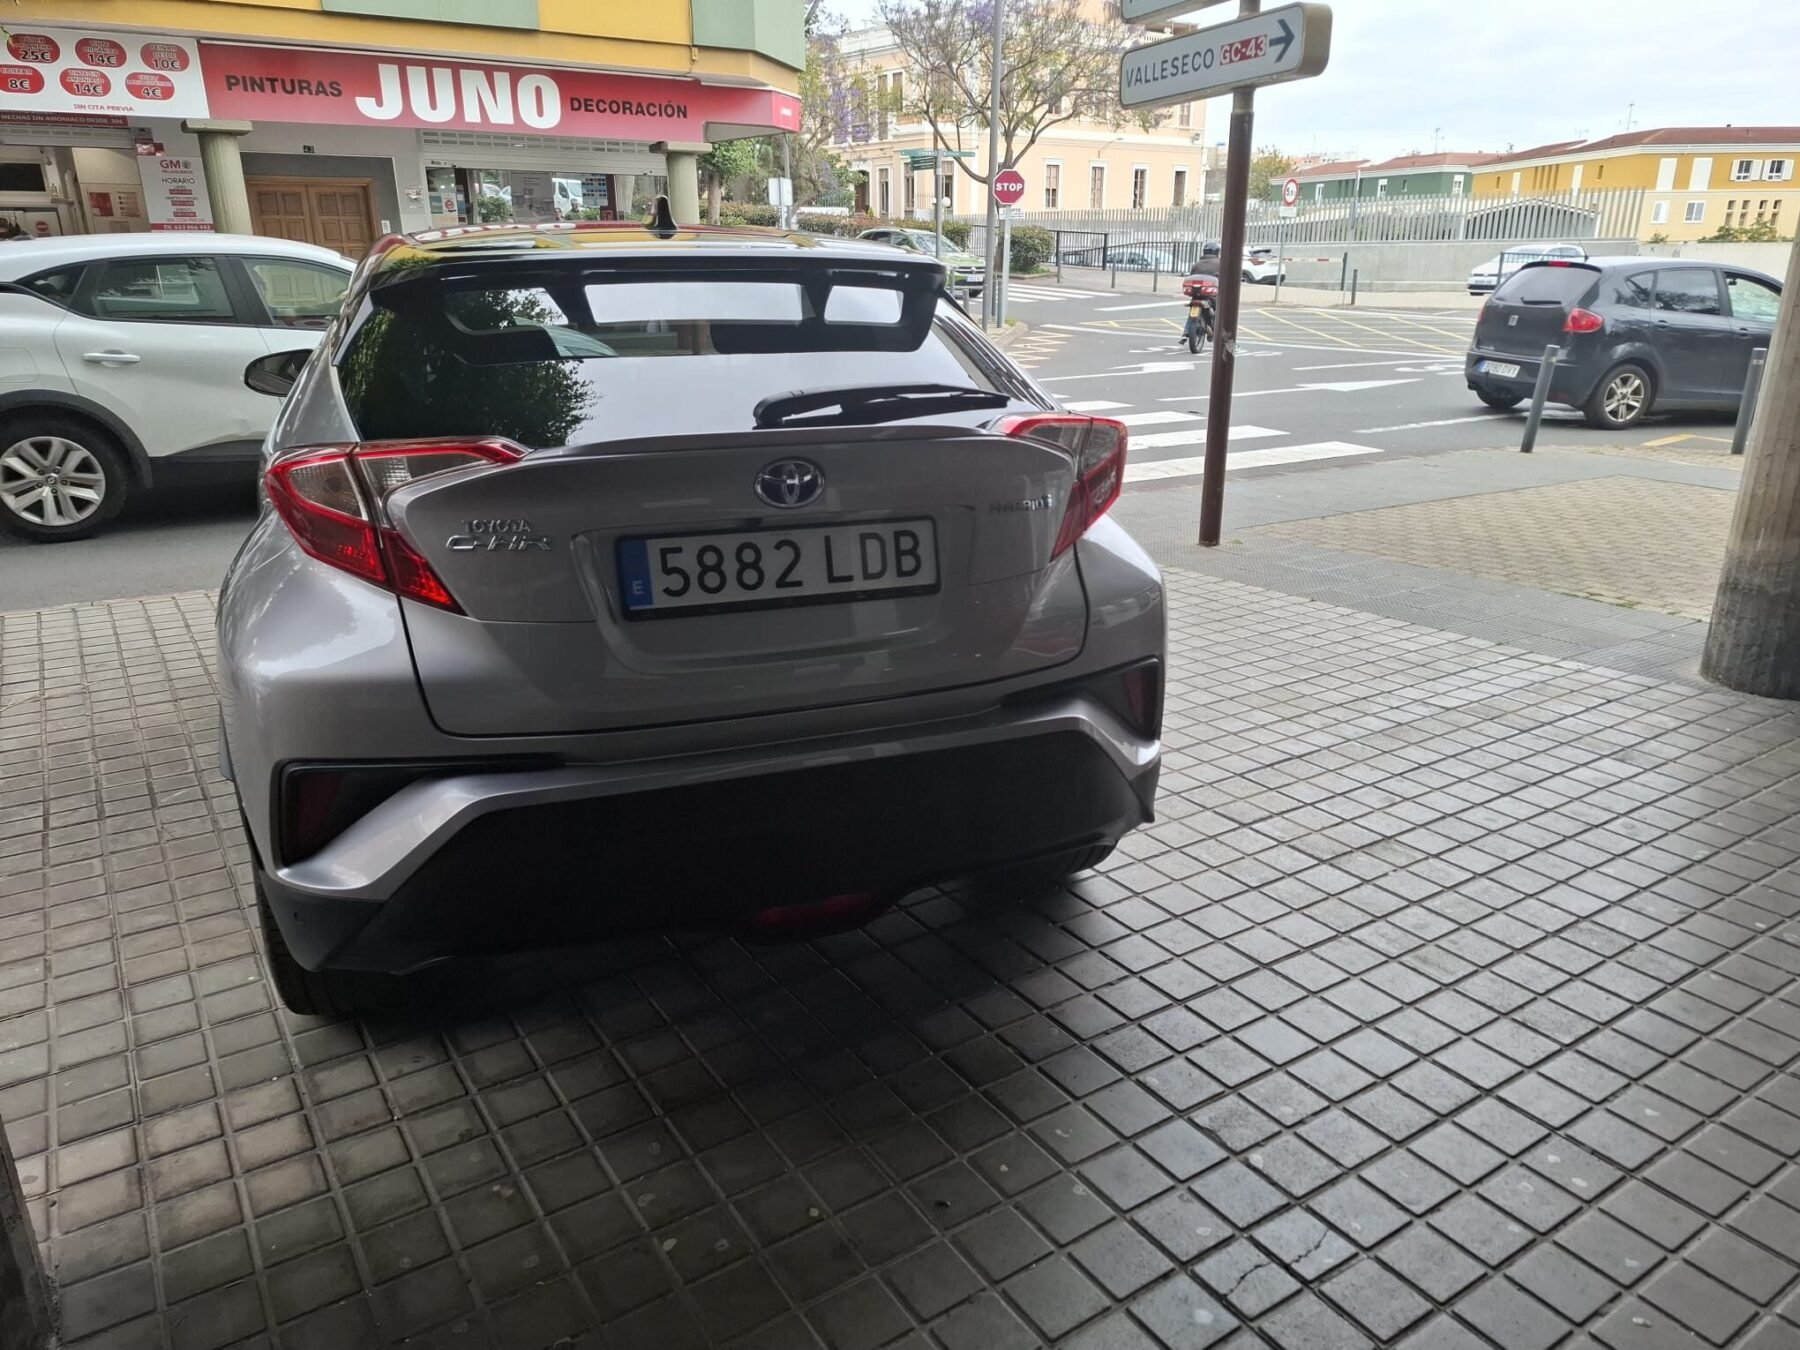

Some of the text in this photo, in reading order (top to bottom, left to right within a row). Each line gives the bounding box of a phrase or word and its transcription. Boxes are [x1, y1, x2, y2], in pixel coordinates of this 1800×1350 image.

[20, 50, 51, 62] 25€
[87, 53, 118, 66] 14€
[1126, 35, 1267, 88] VALLESECO GC-43
[152, 58, 181, 70] 10€
[8, 78, 31, 90] 8€
[73, 82, 103, 95] 14€
[142, 87, 162, 99] 4€
[225, 63, 688, 129] PINTURAS JUNO DECORACIÓN
[160, 159, 181, 169] GM
[162, 177, 196, 185] HORARIO
[996, 182, 1023, 192] STOP
[461, 519, 532, 533] TOYOTA
[445, 535, 552, 551] C-HR
[659, 530, 922, 598] 5882 LDB
[632, 580, 645, 595] E
